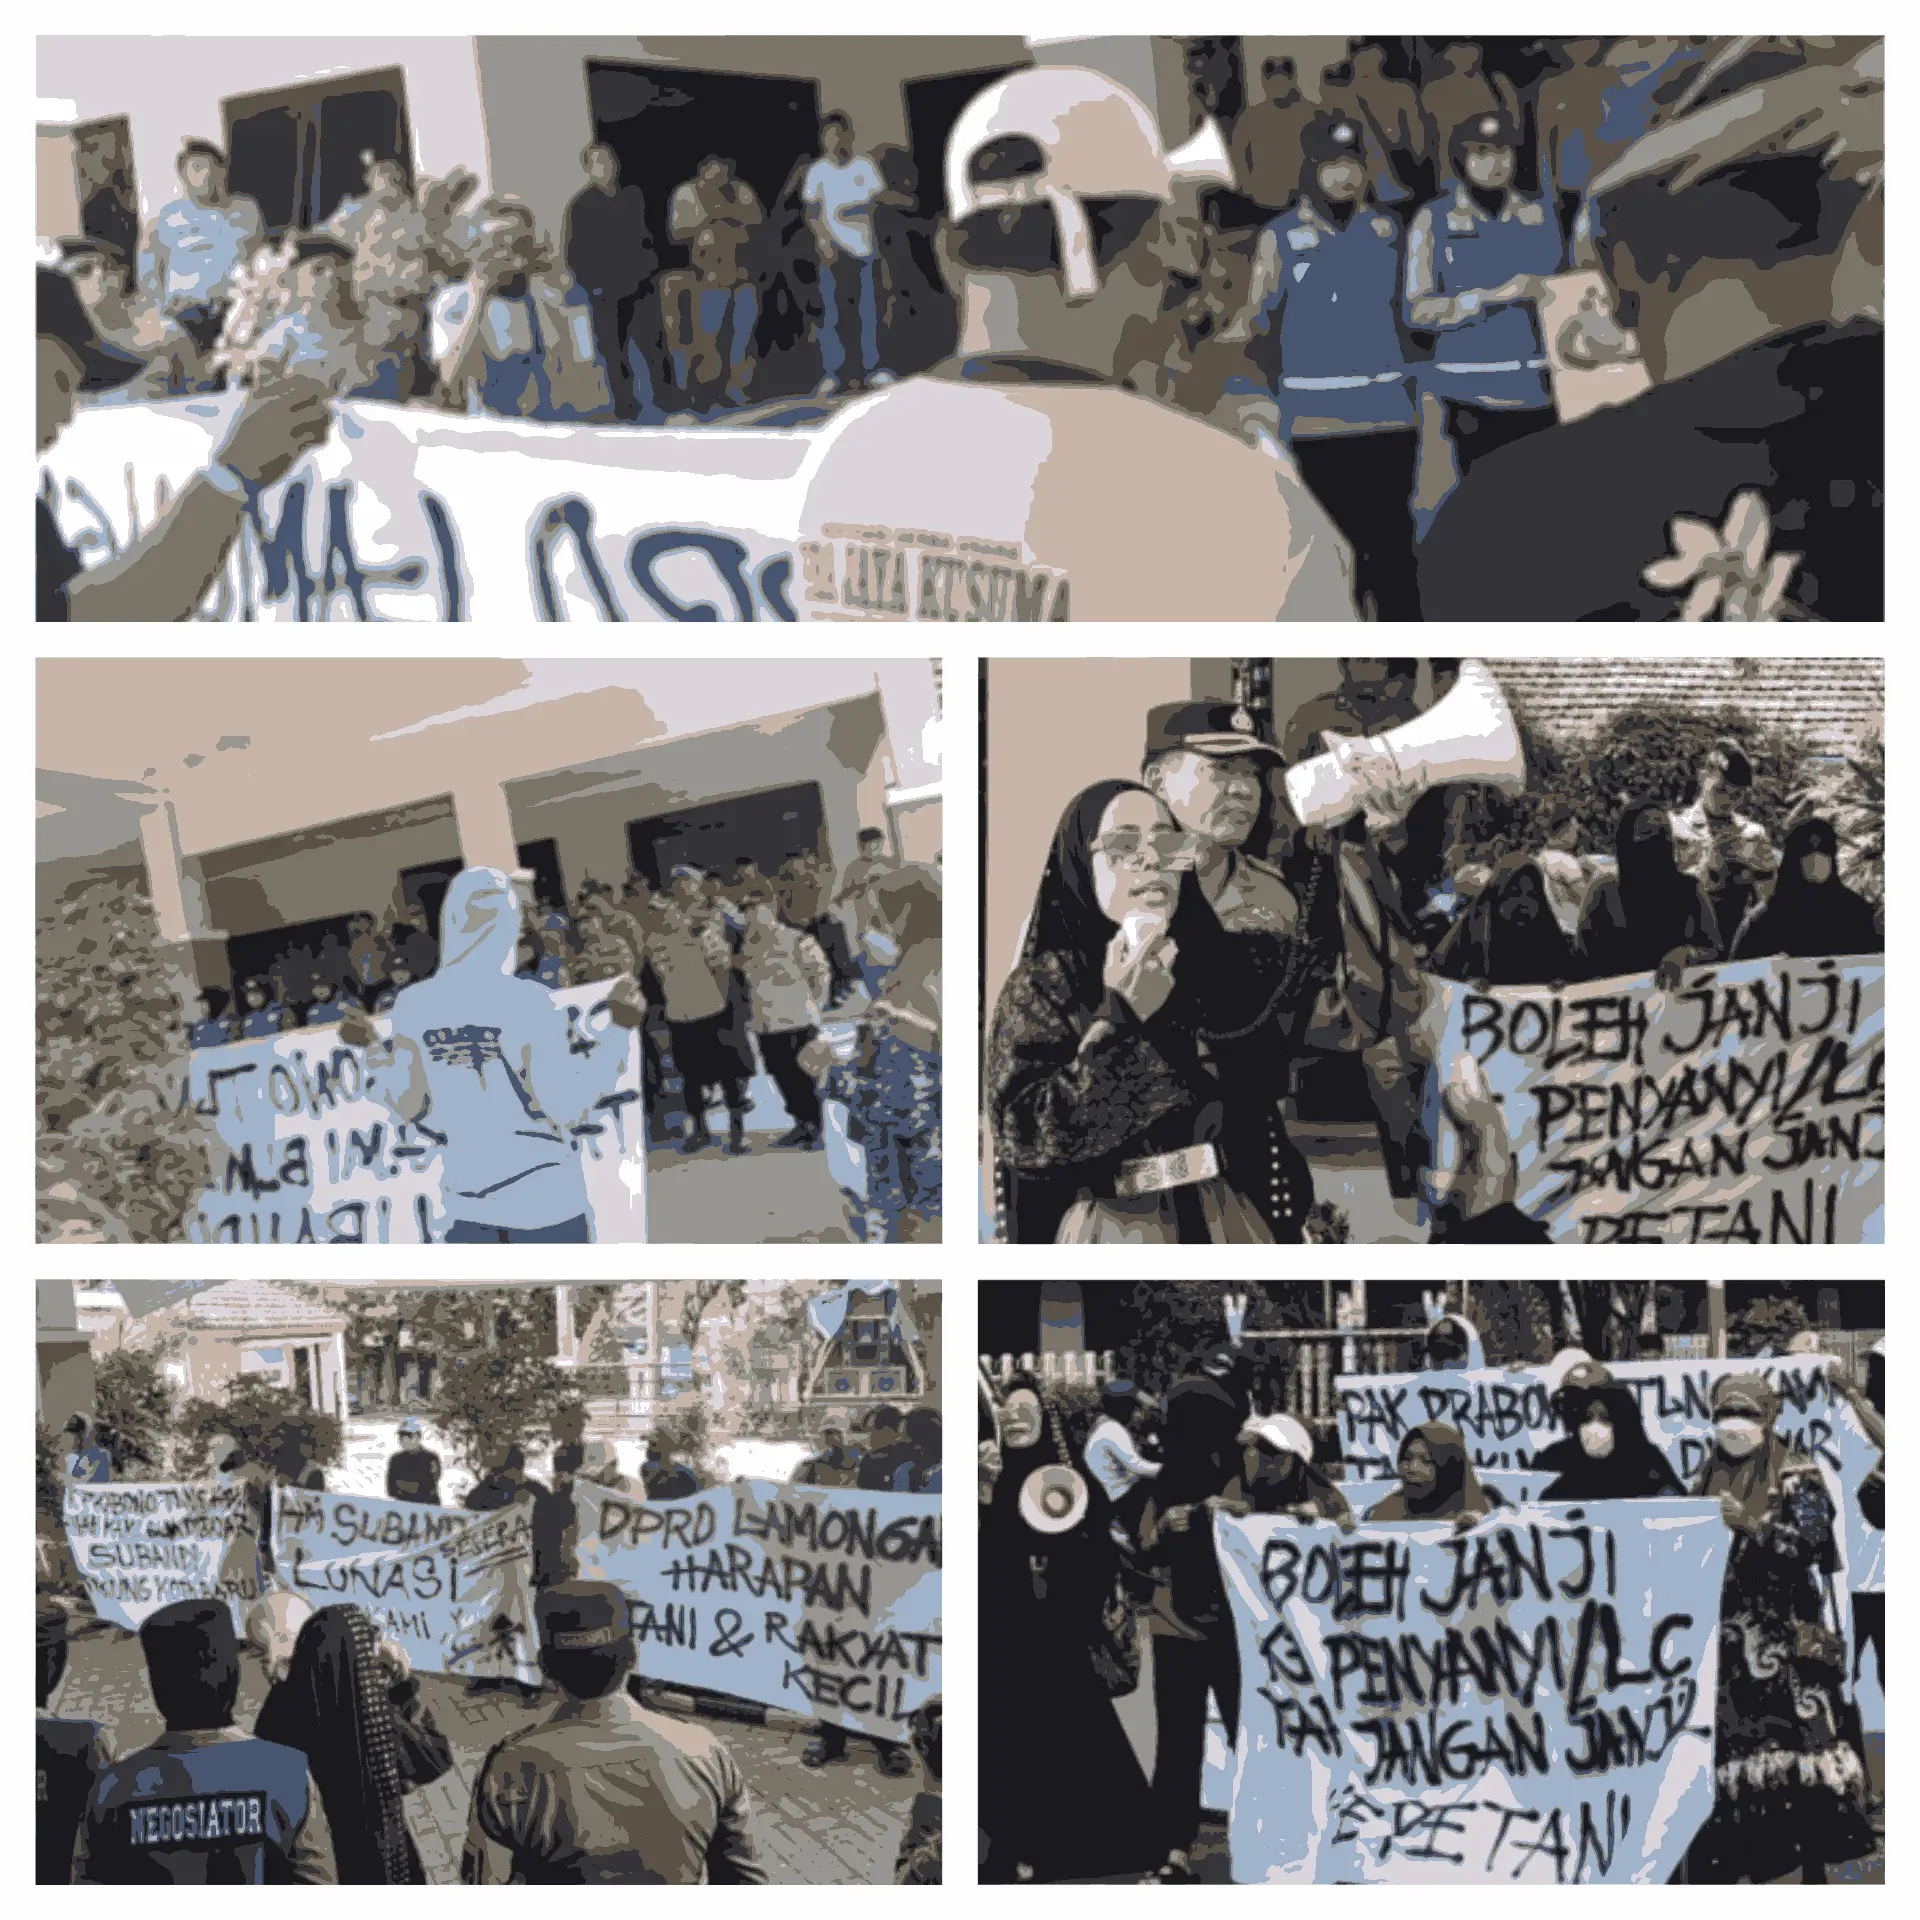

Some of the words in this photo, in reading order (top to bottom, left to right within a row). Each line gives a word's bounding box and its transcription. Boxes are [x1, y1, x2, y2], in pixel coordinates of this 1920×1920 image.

[1461, 994, 1649, 1070] BOLEH
[1662, 959, 1863, 1054] JANJI
[1341, 1386, 1409, 1445] PAK
[599, 1499, 717, 1550] DPRD
[732, 1496, 942, 1568] LAMONGA
[1261, 1539, 1411, 1621] BOLEH
[1419, 1507, 1616, 1616] JANJI
[293, 1546, 458, 1603] LUNASI
[660, 1542, 873, 1618] HARAPAN
[386, 1608, 432, 1640] AMI
[708, 1607, 755, 1657] &
[763, 1611, 942, 1678] RAKYAT
[783, 1659, 918, 1723] KECIL
[1351, 1708, 1551, 1786] JANGAN
[129, 1798, 264, 1845] NEGOSIATOR
